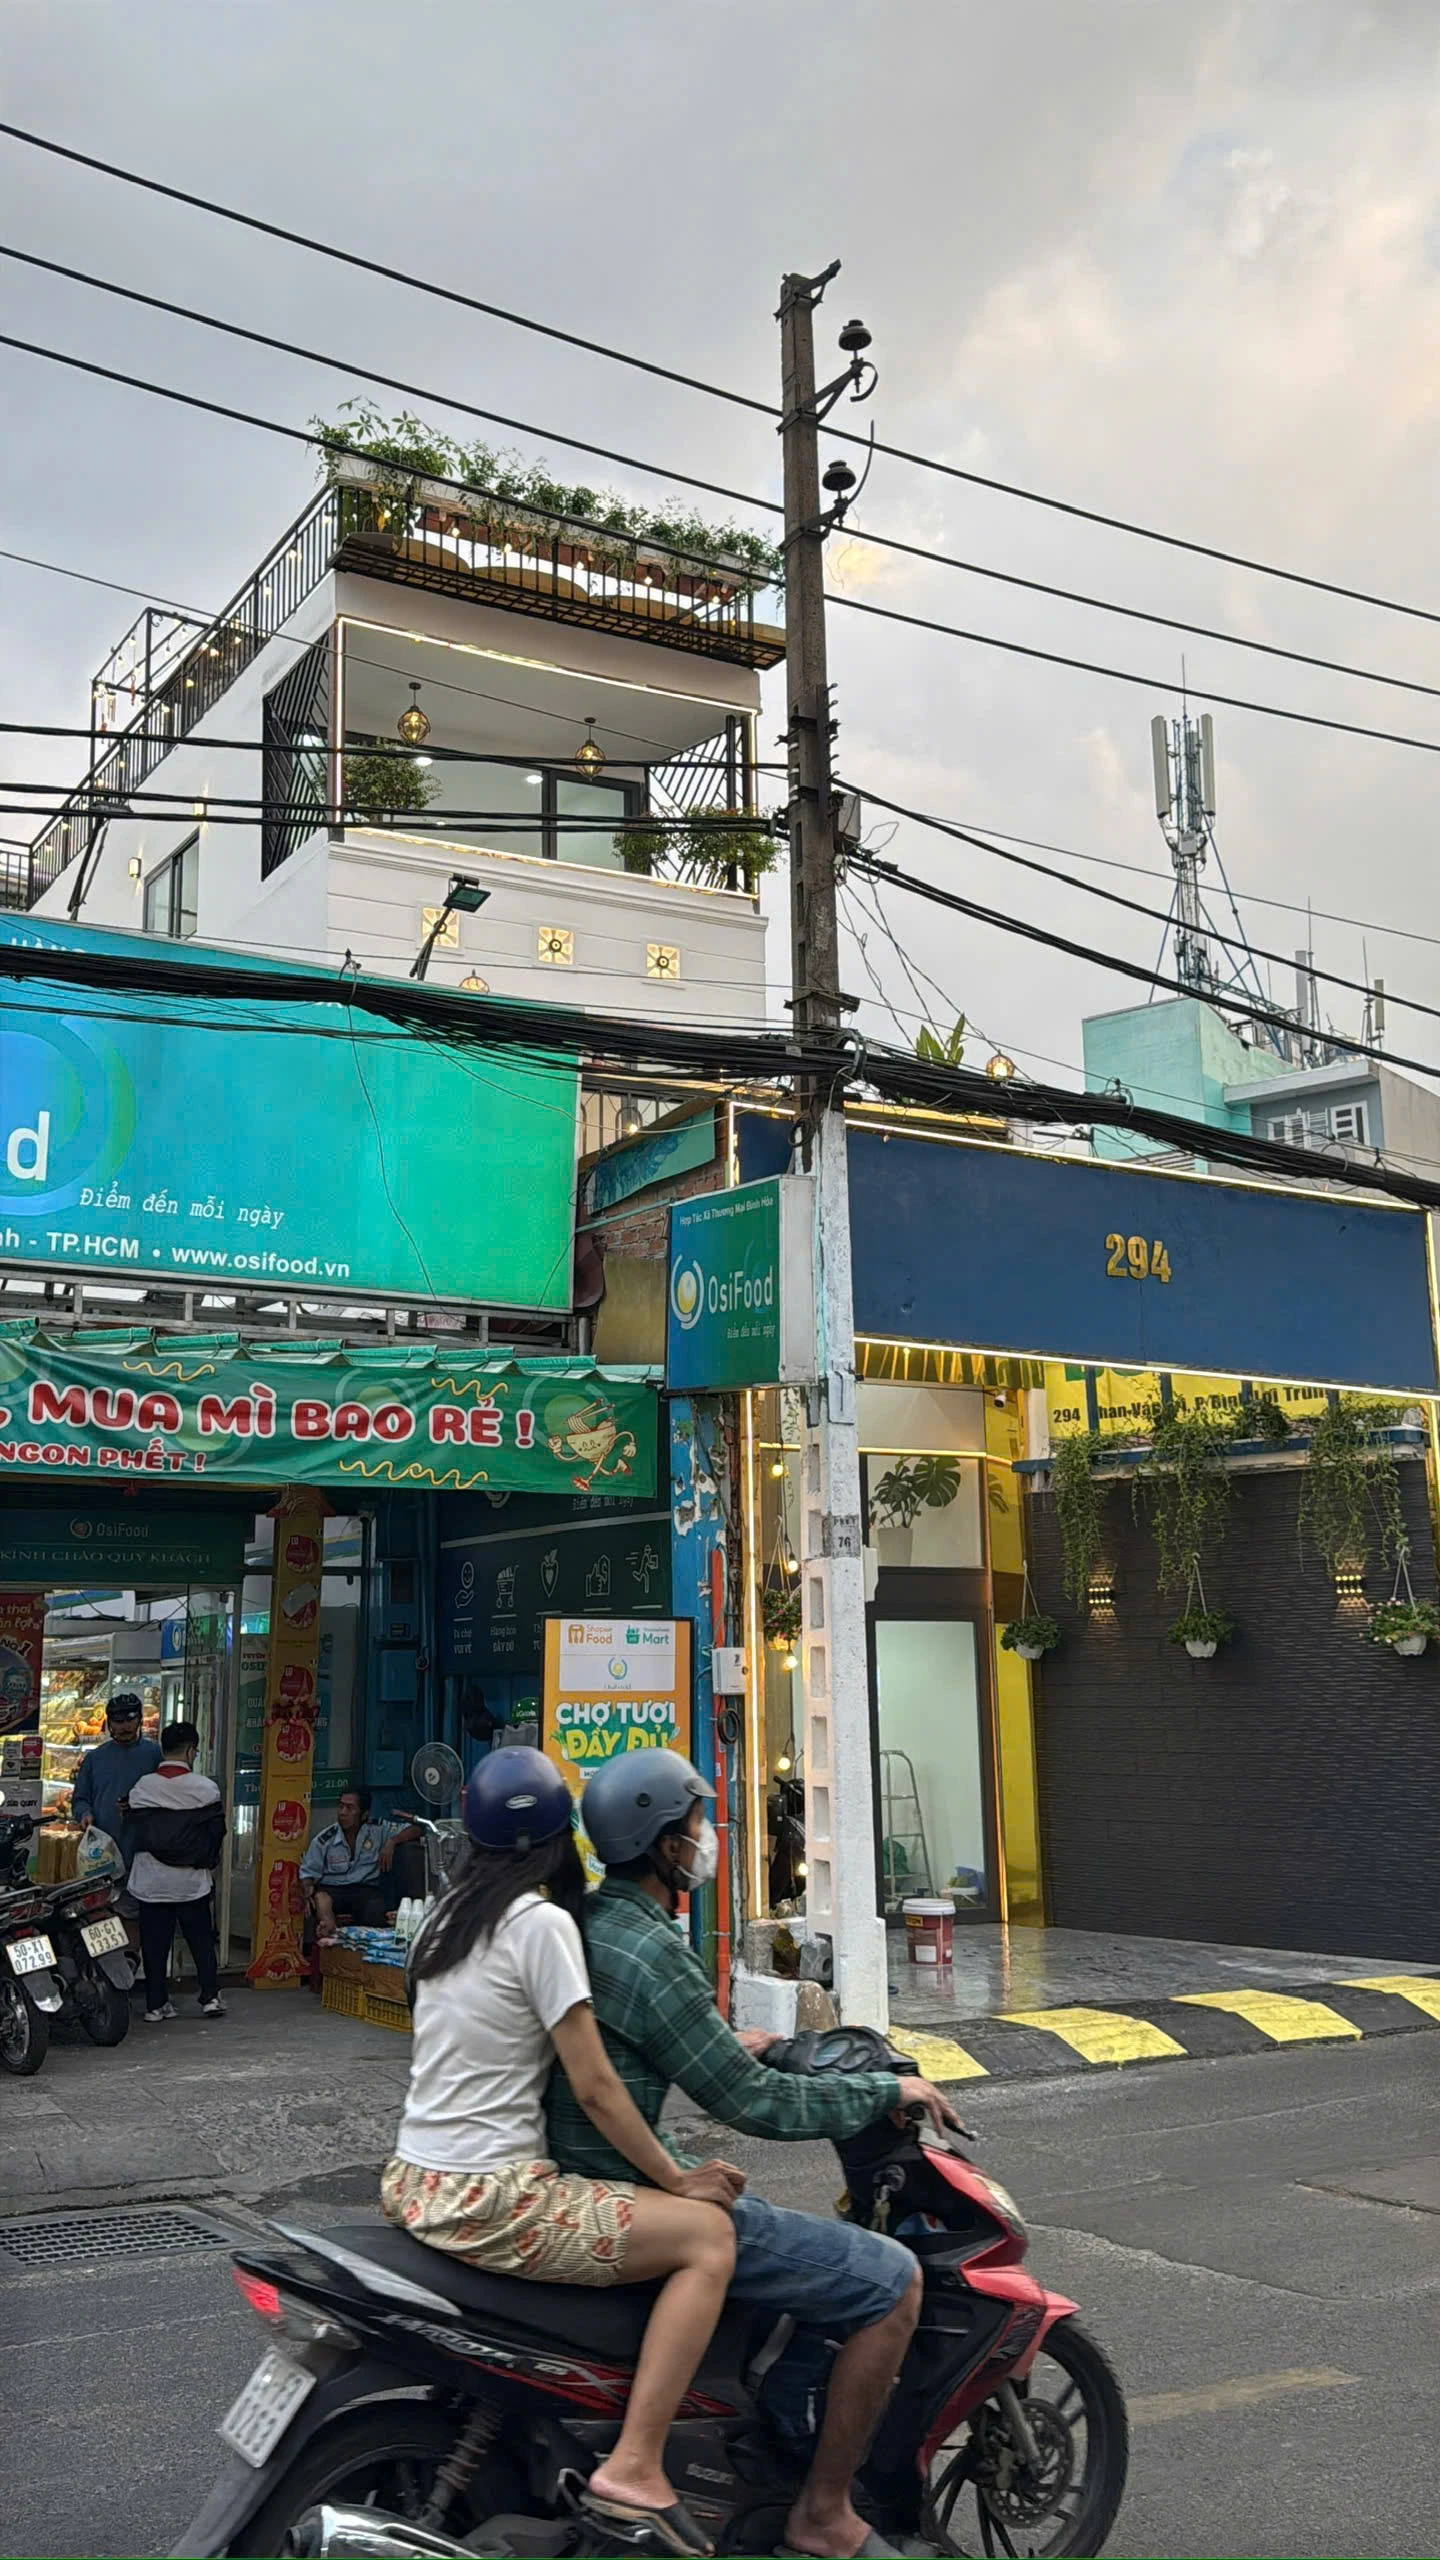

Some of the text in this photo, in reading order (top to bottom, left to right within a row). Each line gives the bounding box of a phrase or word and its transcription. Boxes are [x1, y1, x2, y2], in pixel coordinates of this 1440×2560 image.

[80, 1181, 285, 1229] Điểm đến mỗi ngày
[47, 1231, 139, 1258] TP.HCM
[172, 1247, 350, 1278] www.osifood.vn
[1104, 1232, 1172, 1284] 294
[708, 1265, 773, 1314] OsiFood
[31, 1382, 535, 1448] MUA MÌ BAO RẺ !
[1053, 1407, 1081, 1423] 294
[0, 1438, 206, 1471] NGON PHẾT !
[96, 1521, 151, 1537] OsiFood
[587, 1633, 613, 1644] Food
[643, 1633, 669, 1645] Mart
[556, 1700, 676, 1727] CHỢ TƯƠI
[566, 1727, 622, 1759] ĐẦY
[88, 1921, 117, 1942] 60-G1
[14, 1939, 44, 1958] 50-X1
[90, 1933, 126, 1955] 133.51
[15, 1951, 53, 1972] 072.99
